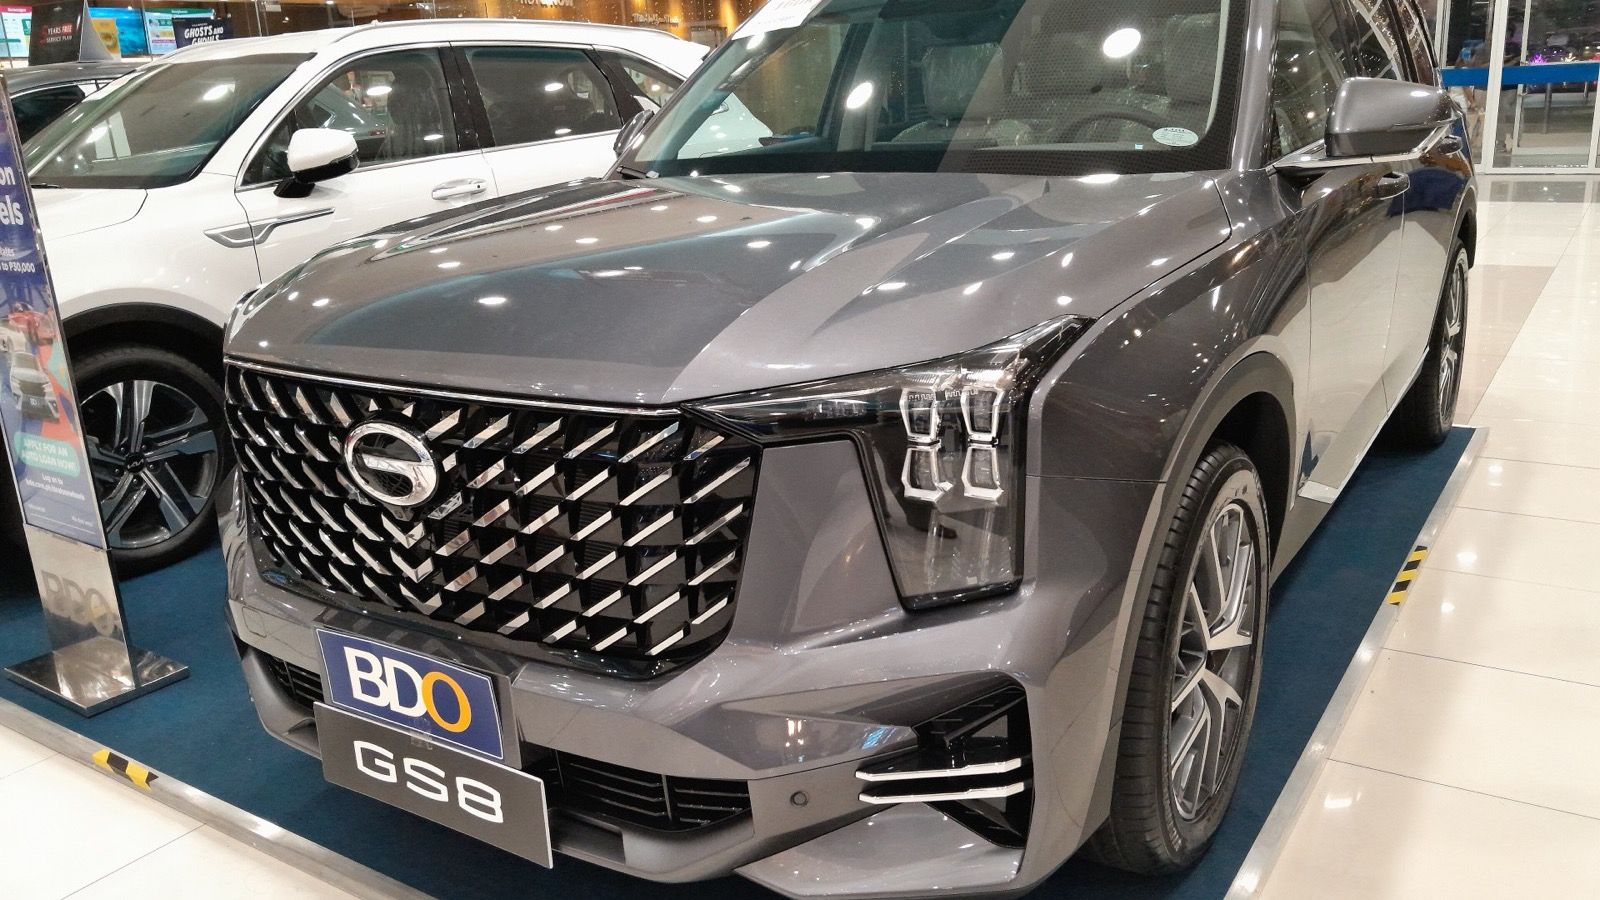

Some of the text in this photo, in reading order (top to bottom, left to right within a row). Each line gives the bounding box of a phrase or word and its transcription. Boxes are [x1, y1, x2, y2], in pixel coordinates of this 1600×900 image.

[184, 25, 224, 39] GHOSTS AND
[1, 262, 9, 272] to
[343, 646, 473, 733] BDO
[353, 740, 504, 824] GS8
